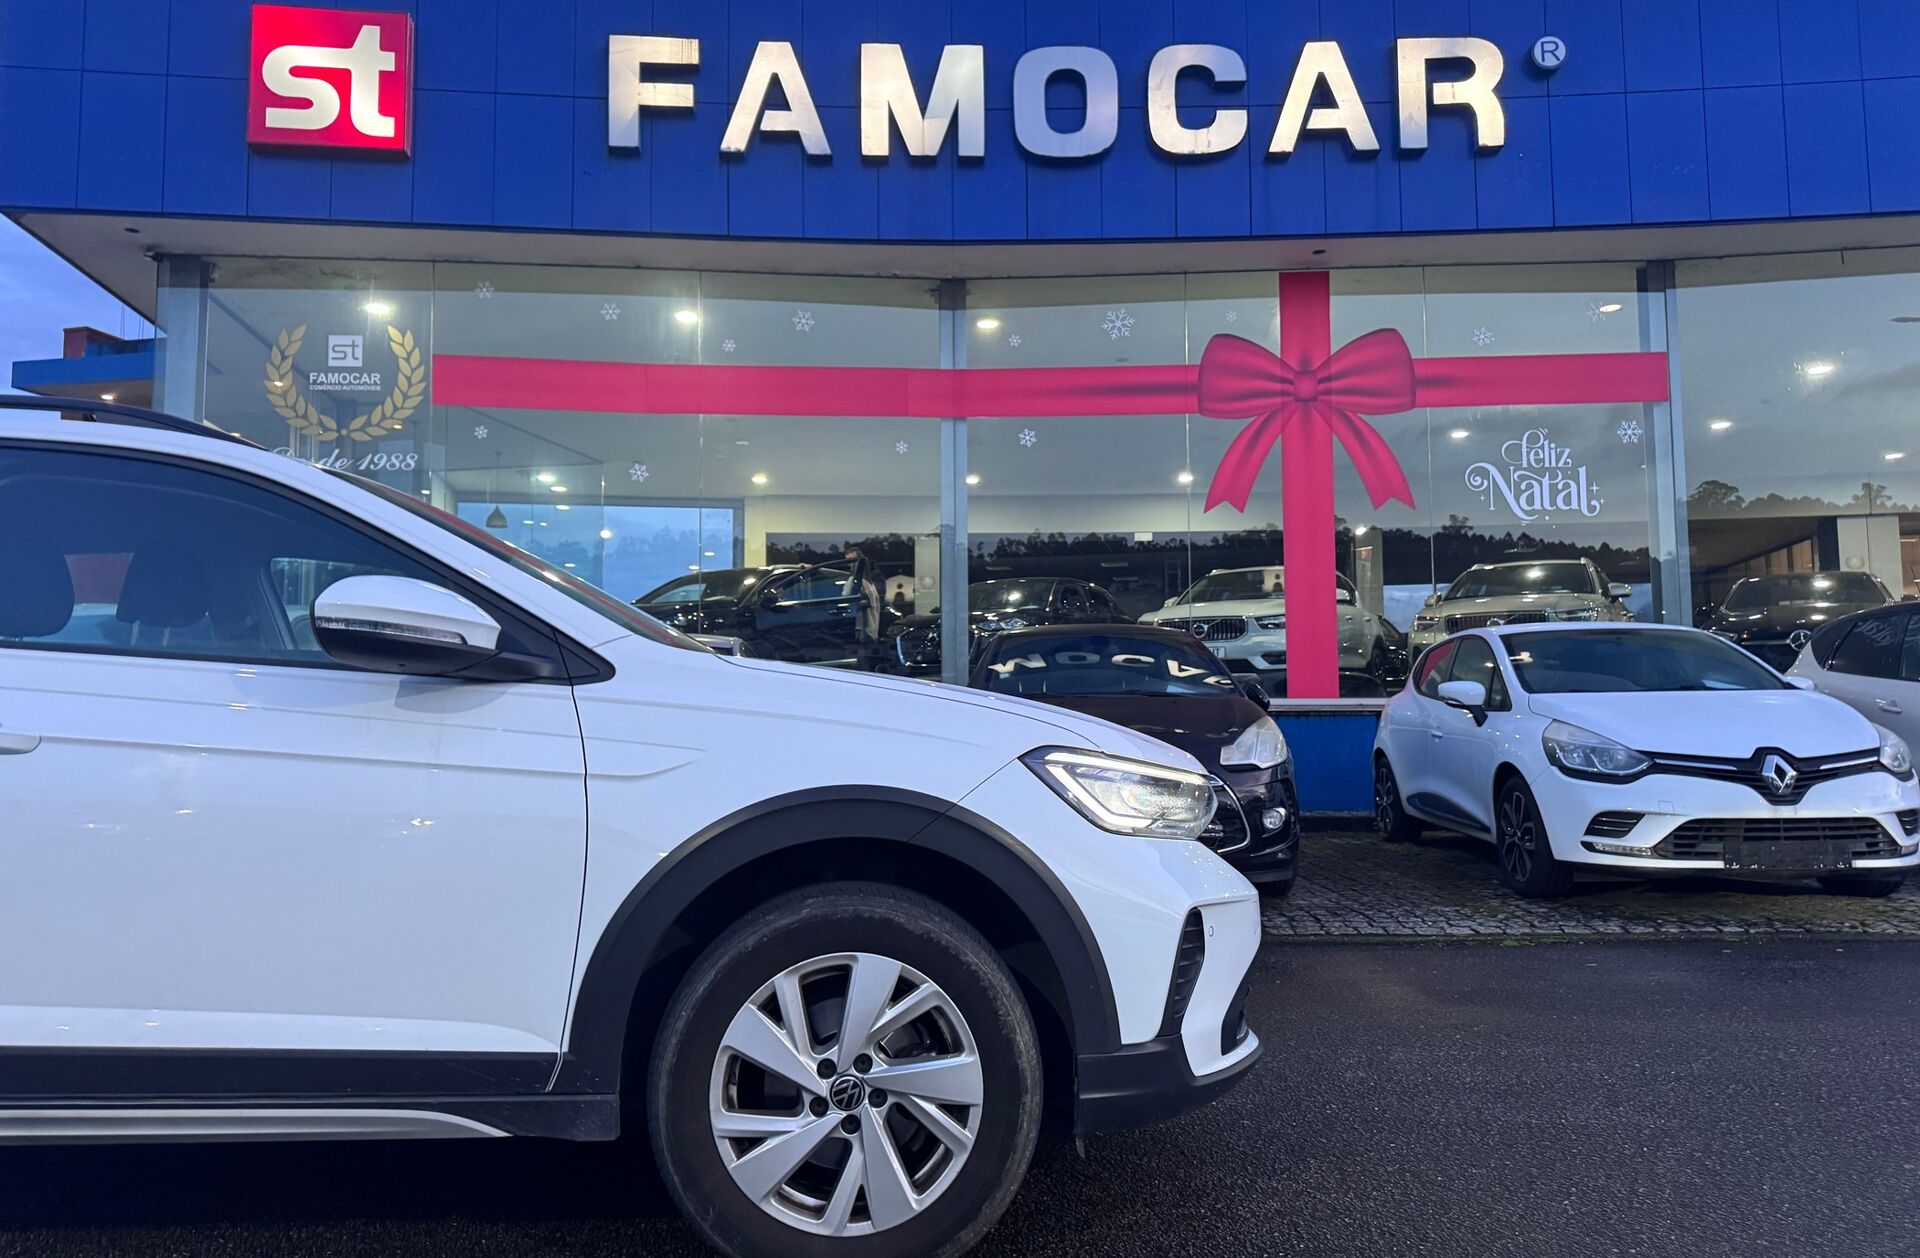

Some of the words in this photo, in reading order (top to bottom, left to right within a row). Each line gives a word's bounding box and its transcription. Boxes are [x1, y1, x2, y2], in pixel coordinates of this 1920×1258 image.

[262, 25, 395, 137] st
[607, 33, 1505, 157] FAMOCAR
[331, 339, 360, 361] st
[309, 372, 381, 384] FAMOCAR
[356, 452, 418, 471] 1988
[1465, 462, 1601, 520] Natal
